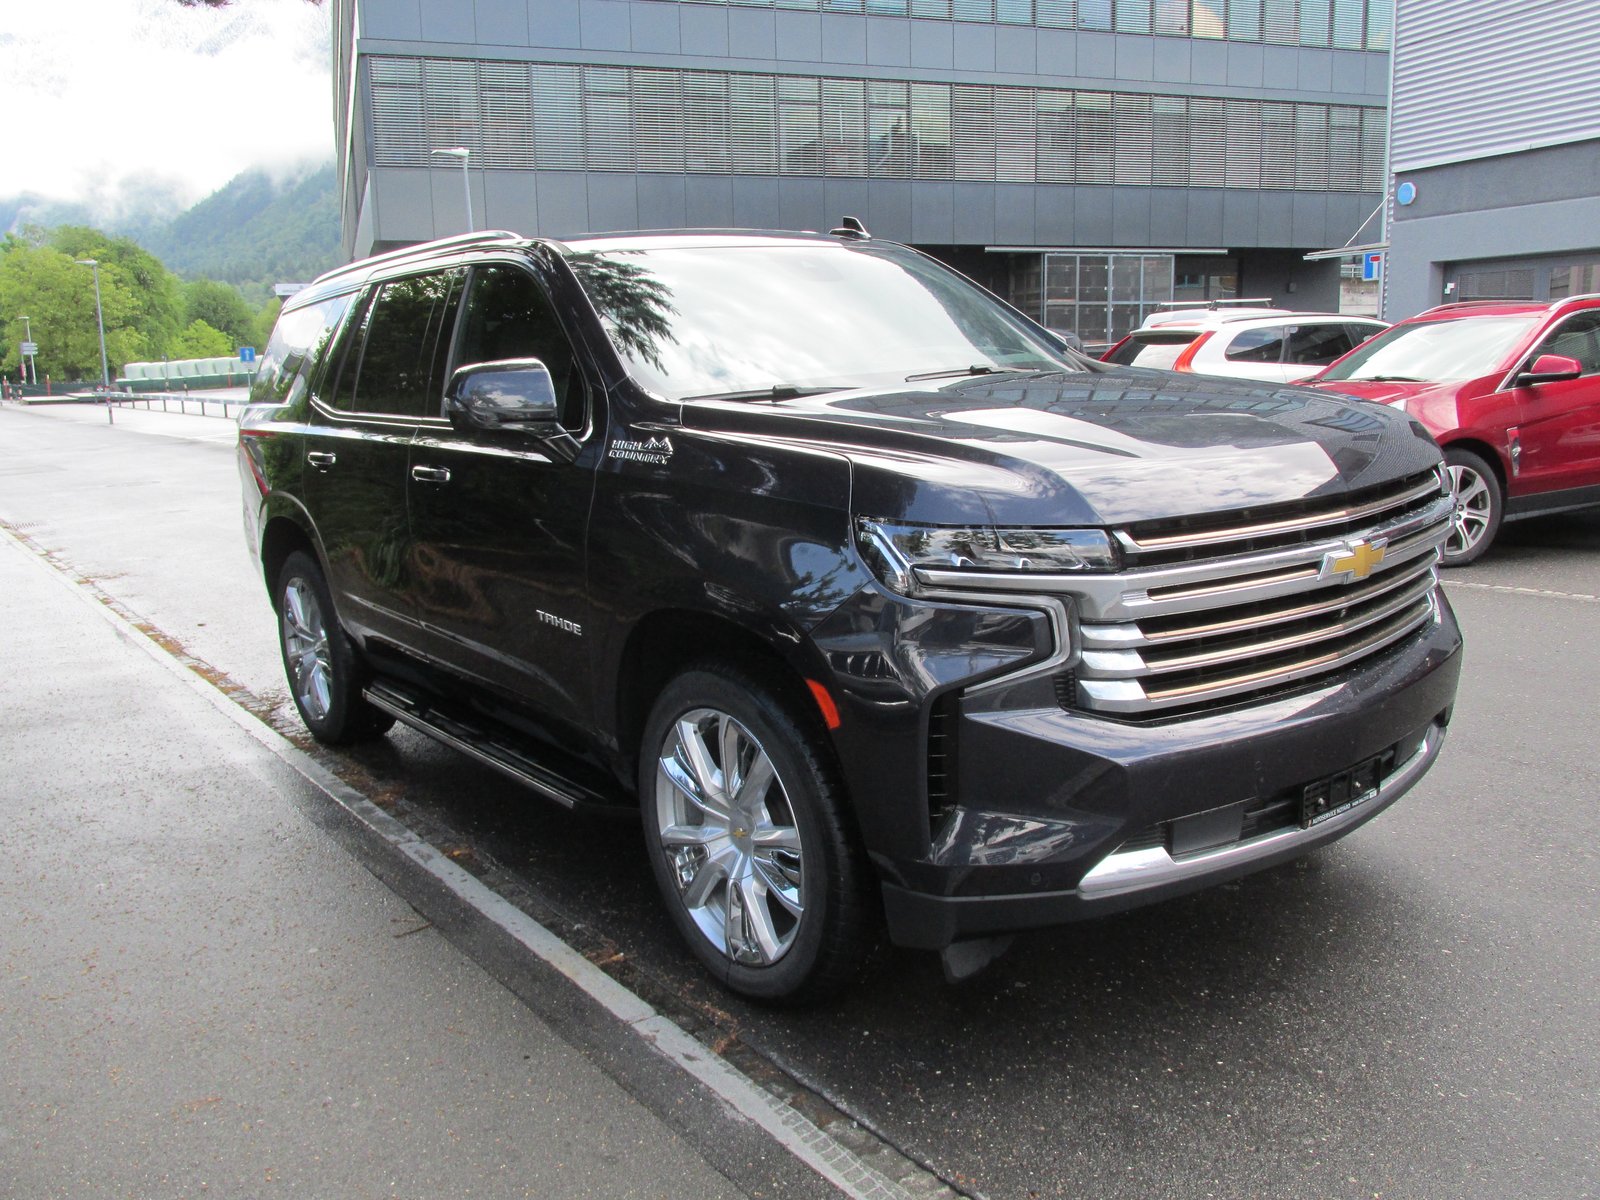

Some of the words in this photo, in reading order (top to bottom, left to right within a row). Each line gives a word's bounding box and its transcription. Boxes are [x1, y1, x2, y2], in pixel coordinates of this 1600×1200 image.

[611, 439, 643, 451] HIGH
[608, 449, 671, 466] COUNTRY
[535, 609, 582, 636] TAHOE
